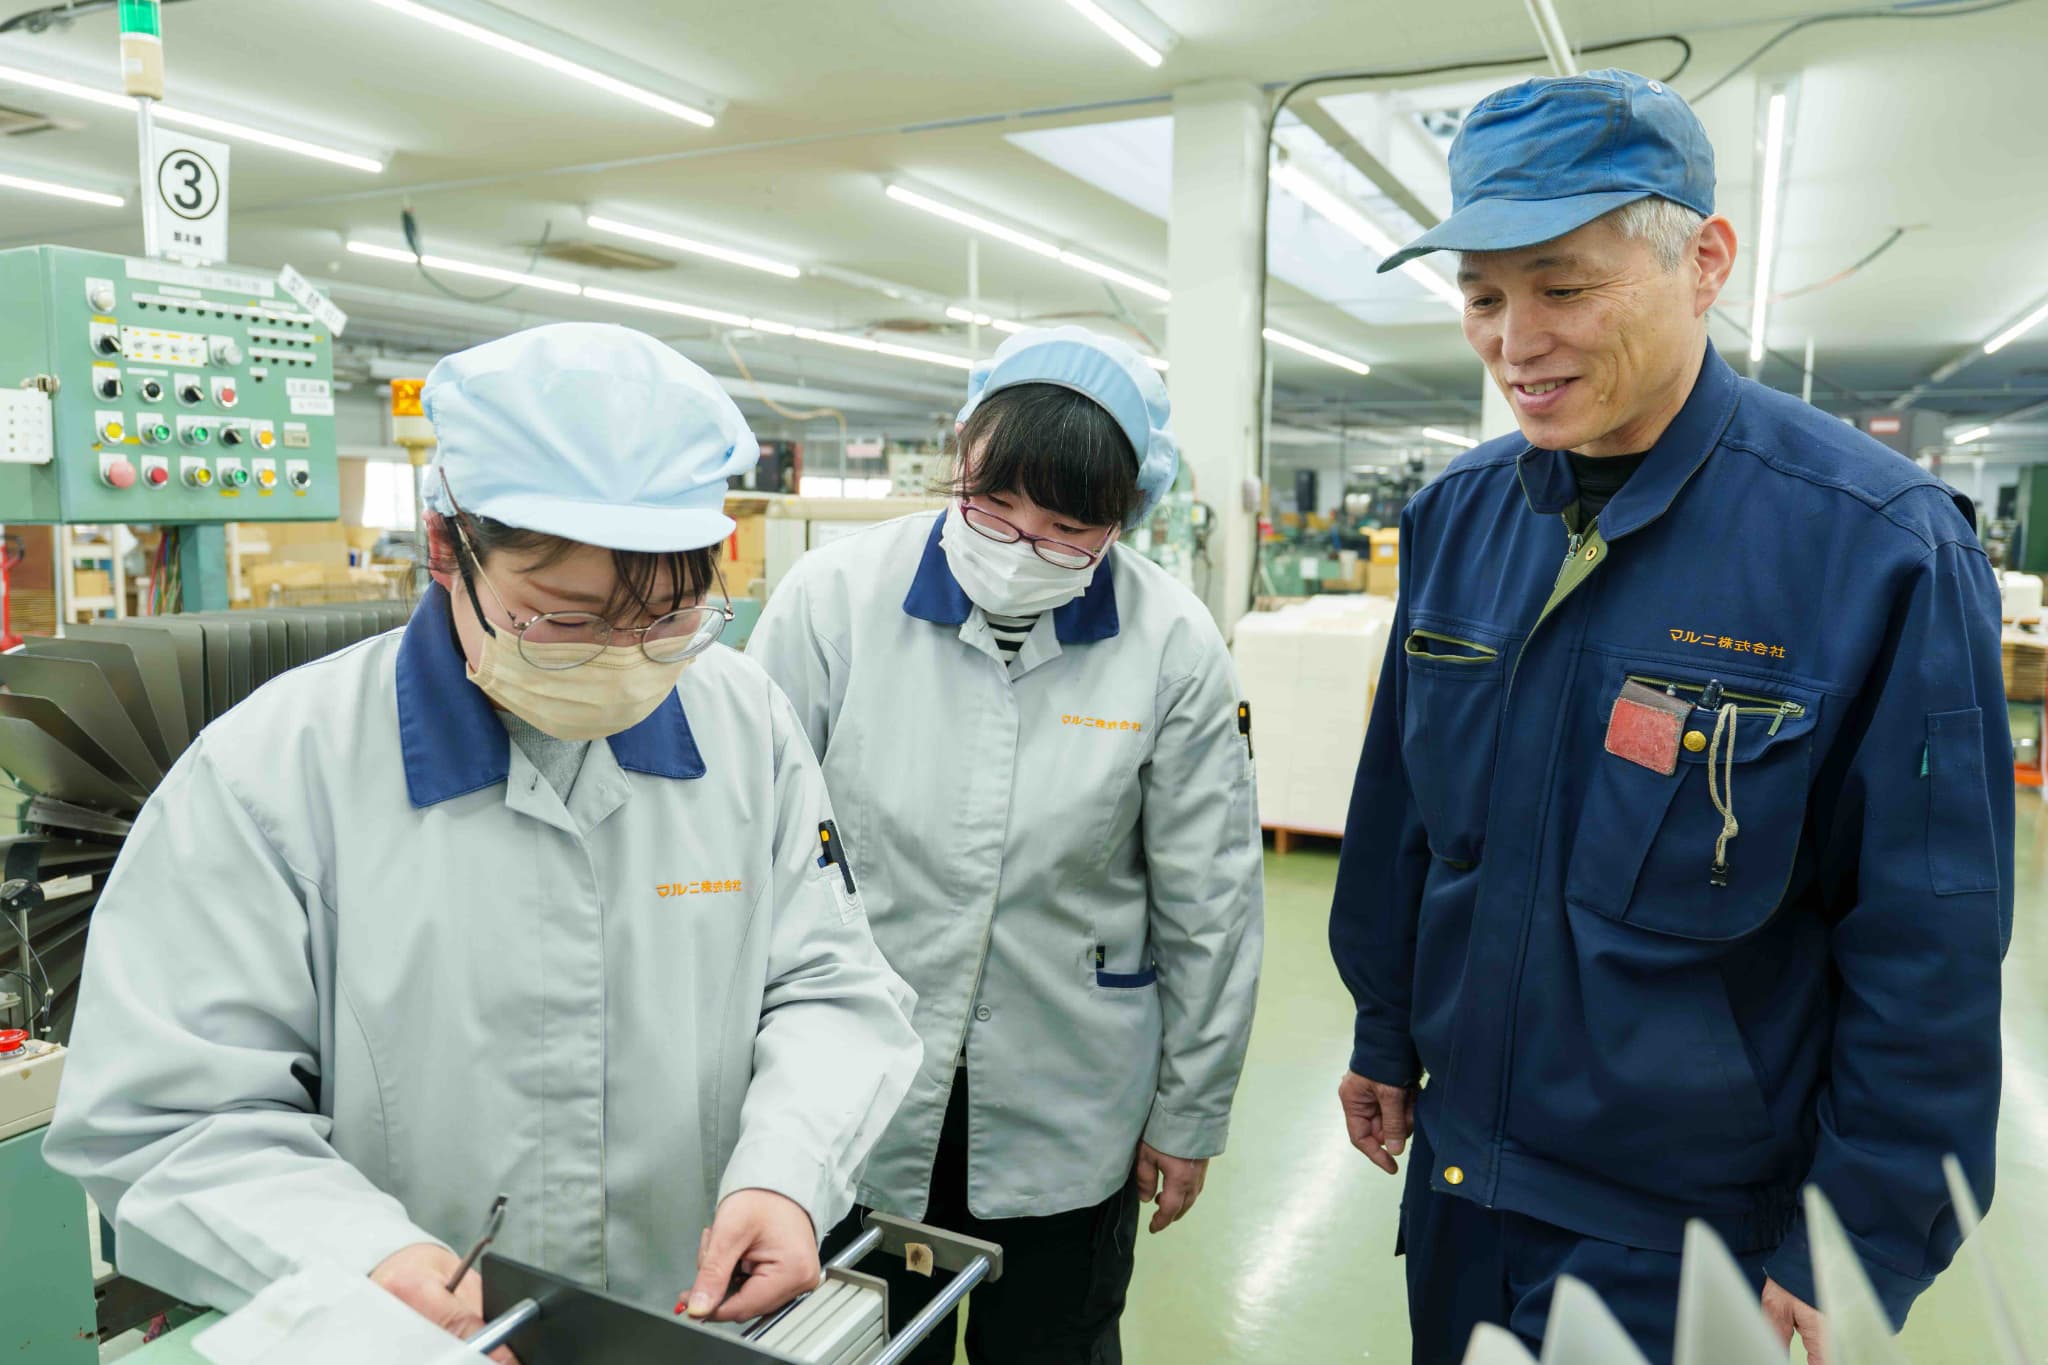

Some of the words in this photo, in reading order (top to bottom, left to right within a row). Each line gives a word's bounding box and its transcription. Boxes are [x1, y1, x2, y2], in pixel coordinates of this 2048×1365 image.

[174, 159, 202, 210] 3
[1669, 629, 1786, 658] マルニ株式会社
[656, 880, 742, 897] マルニ株式会社
